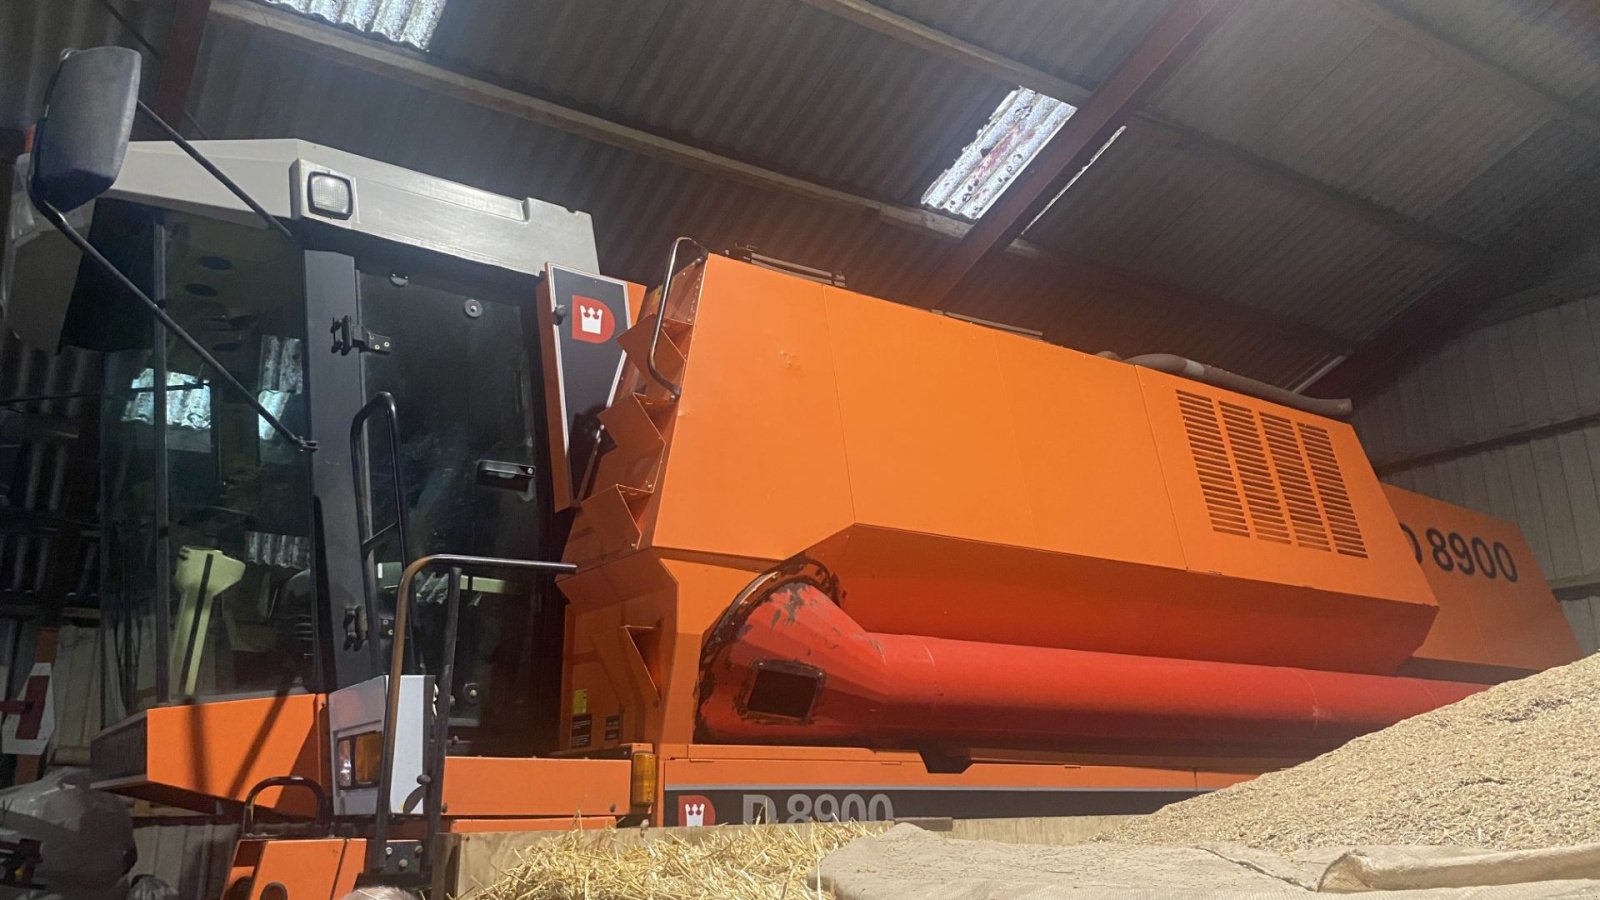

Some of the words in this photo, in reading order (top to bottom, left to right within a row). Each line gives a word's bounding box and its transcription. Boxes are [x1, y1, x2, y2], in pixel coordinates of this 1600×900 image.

[1426, 528, 1518, 582] 8900
[743, 794, 777, 825] D
[786, 793, 894, 823] 8900
